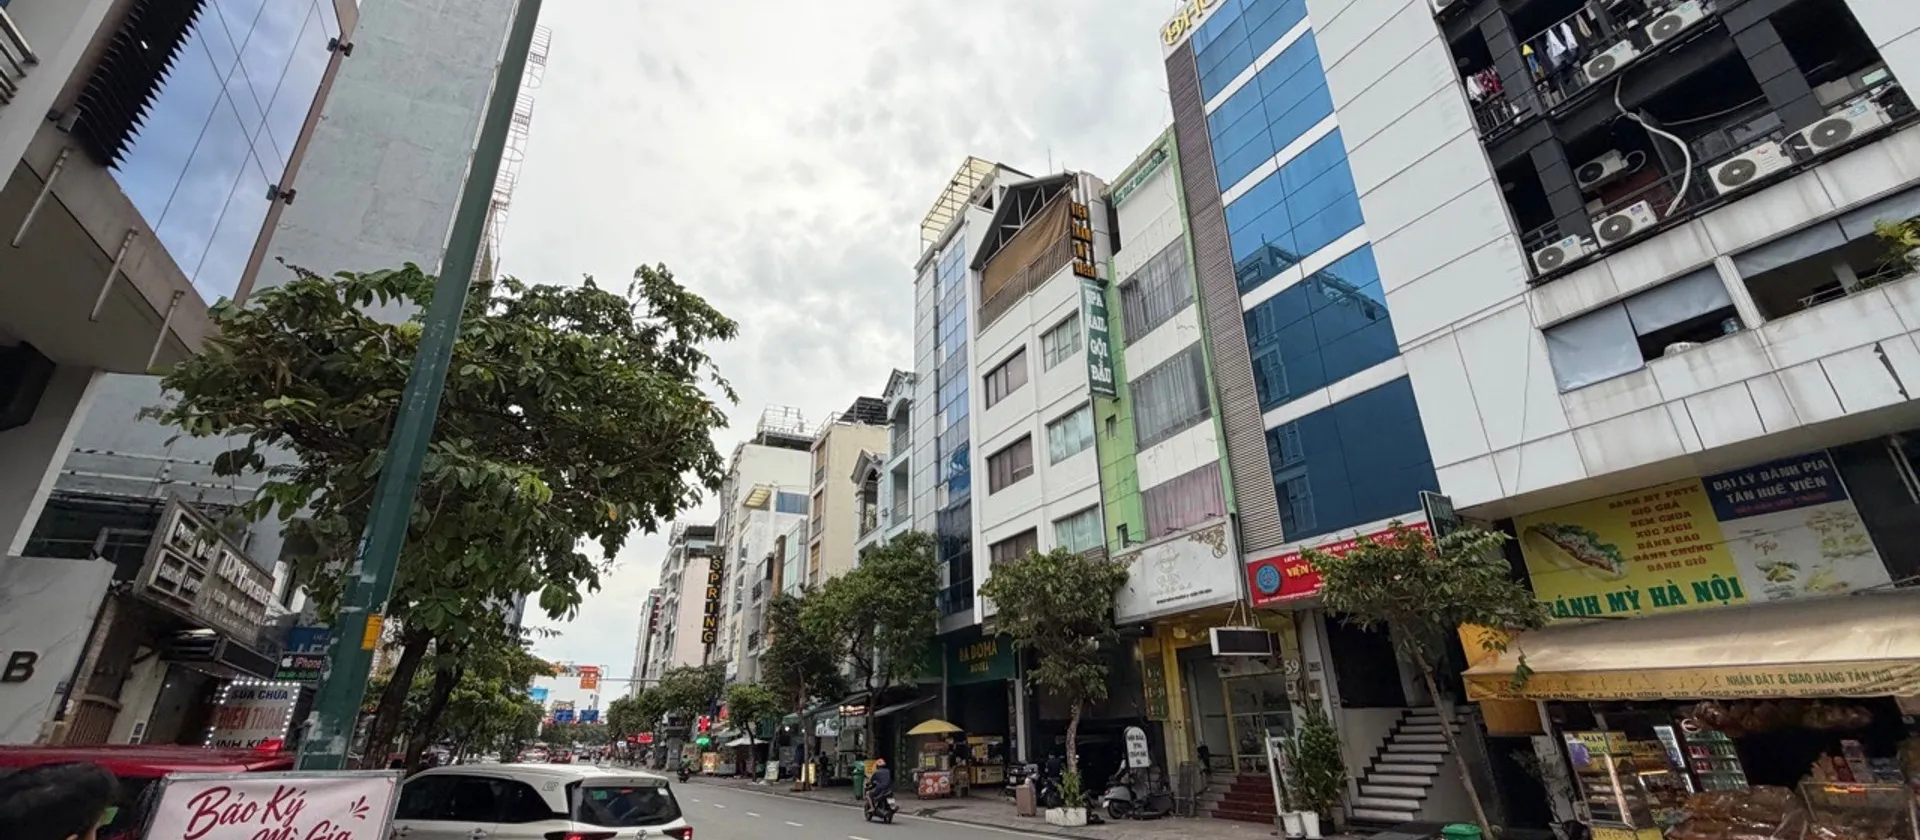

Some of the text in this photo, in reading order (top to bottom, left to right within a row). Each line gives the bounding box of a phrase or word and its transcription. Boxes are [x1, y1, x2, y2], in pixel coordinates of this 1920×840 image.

[1760, 464, 1800, 482] BÁNH
[1286, 564, 1309, 578] VIỆN
[701, 558, 722, 644] SPRING
[1649, 579, 1687, 608] HÀ
[1691, 573, 1744, 606] NỘI
[2, 650, 38, 683] B
[1284, 660, 1299, 675] 59
[1788, 672, 1813, 685] GIAO
[1814, 669, 1845, 684] HÀNG
[184, 785, 307, 840] Bảo Ký
